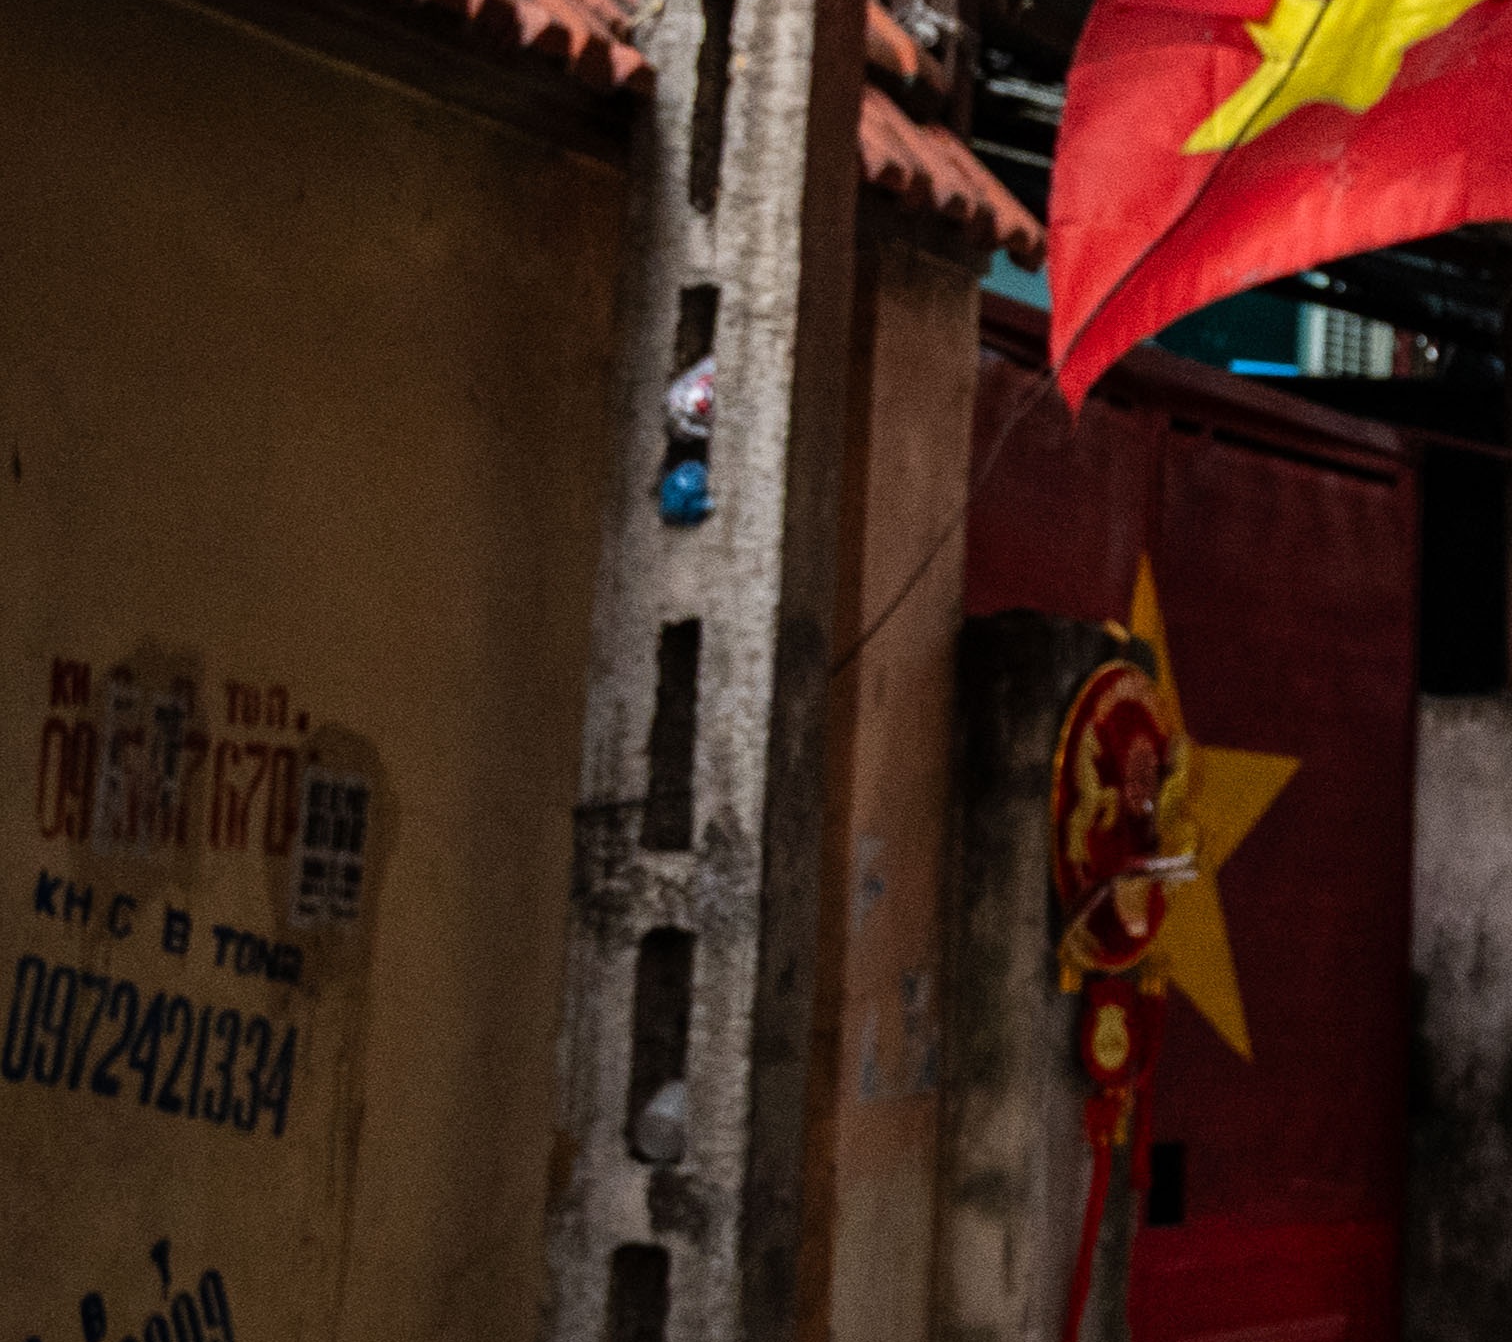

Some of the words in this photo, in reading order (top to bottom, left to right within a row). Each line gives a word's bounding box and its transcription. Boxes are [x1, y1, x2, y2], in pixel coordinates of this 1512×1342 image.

[34, 867, 94, 925] KH
[107, 893, 137, 941] C
[1, 955, 298, 1139] 0972421334
